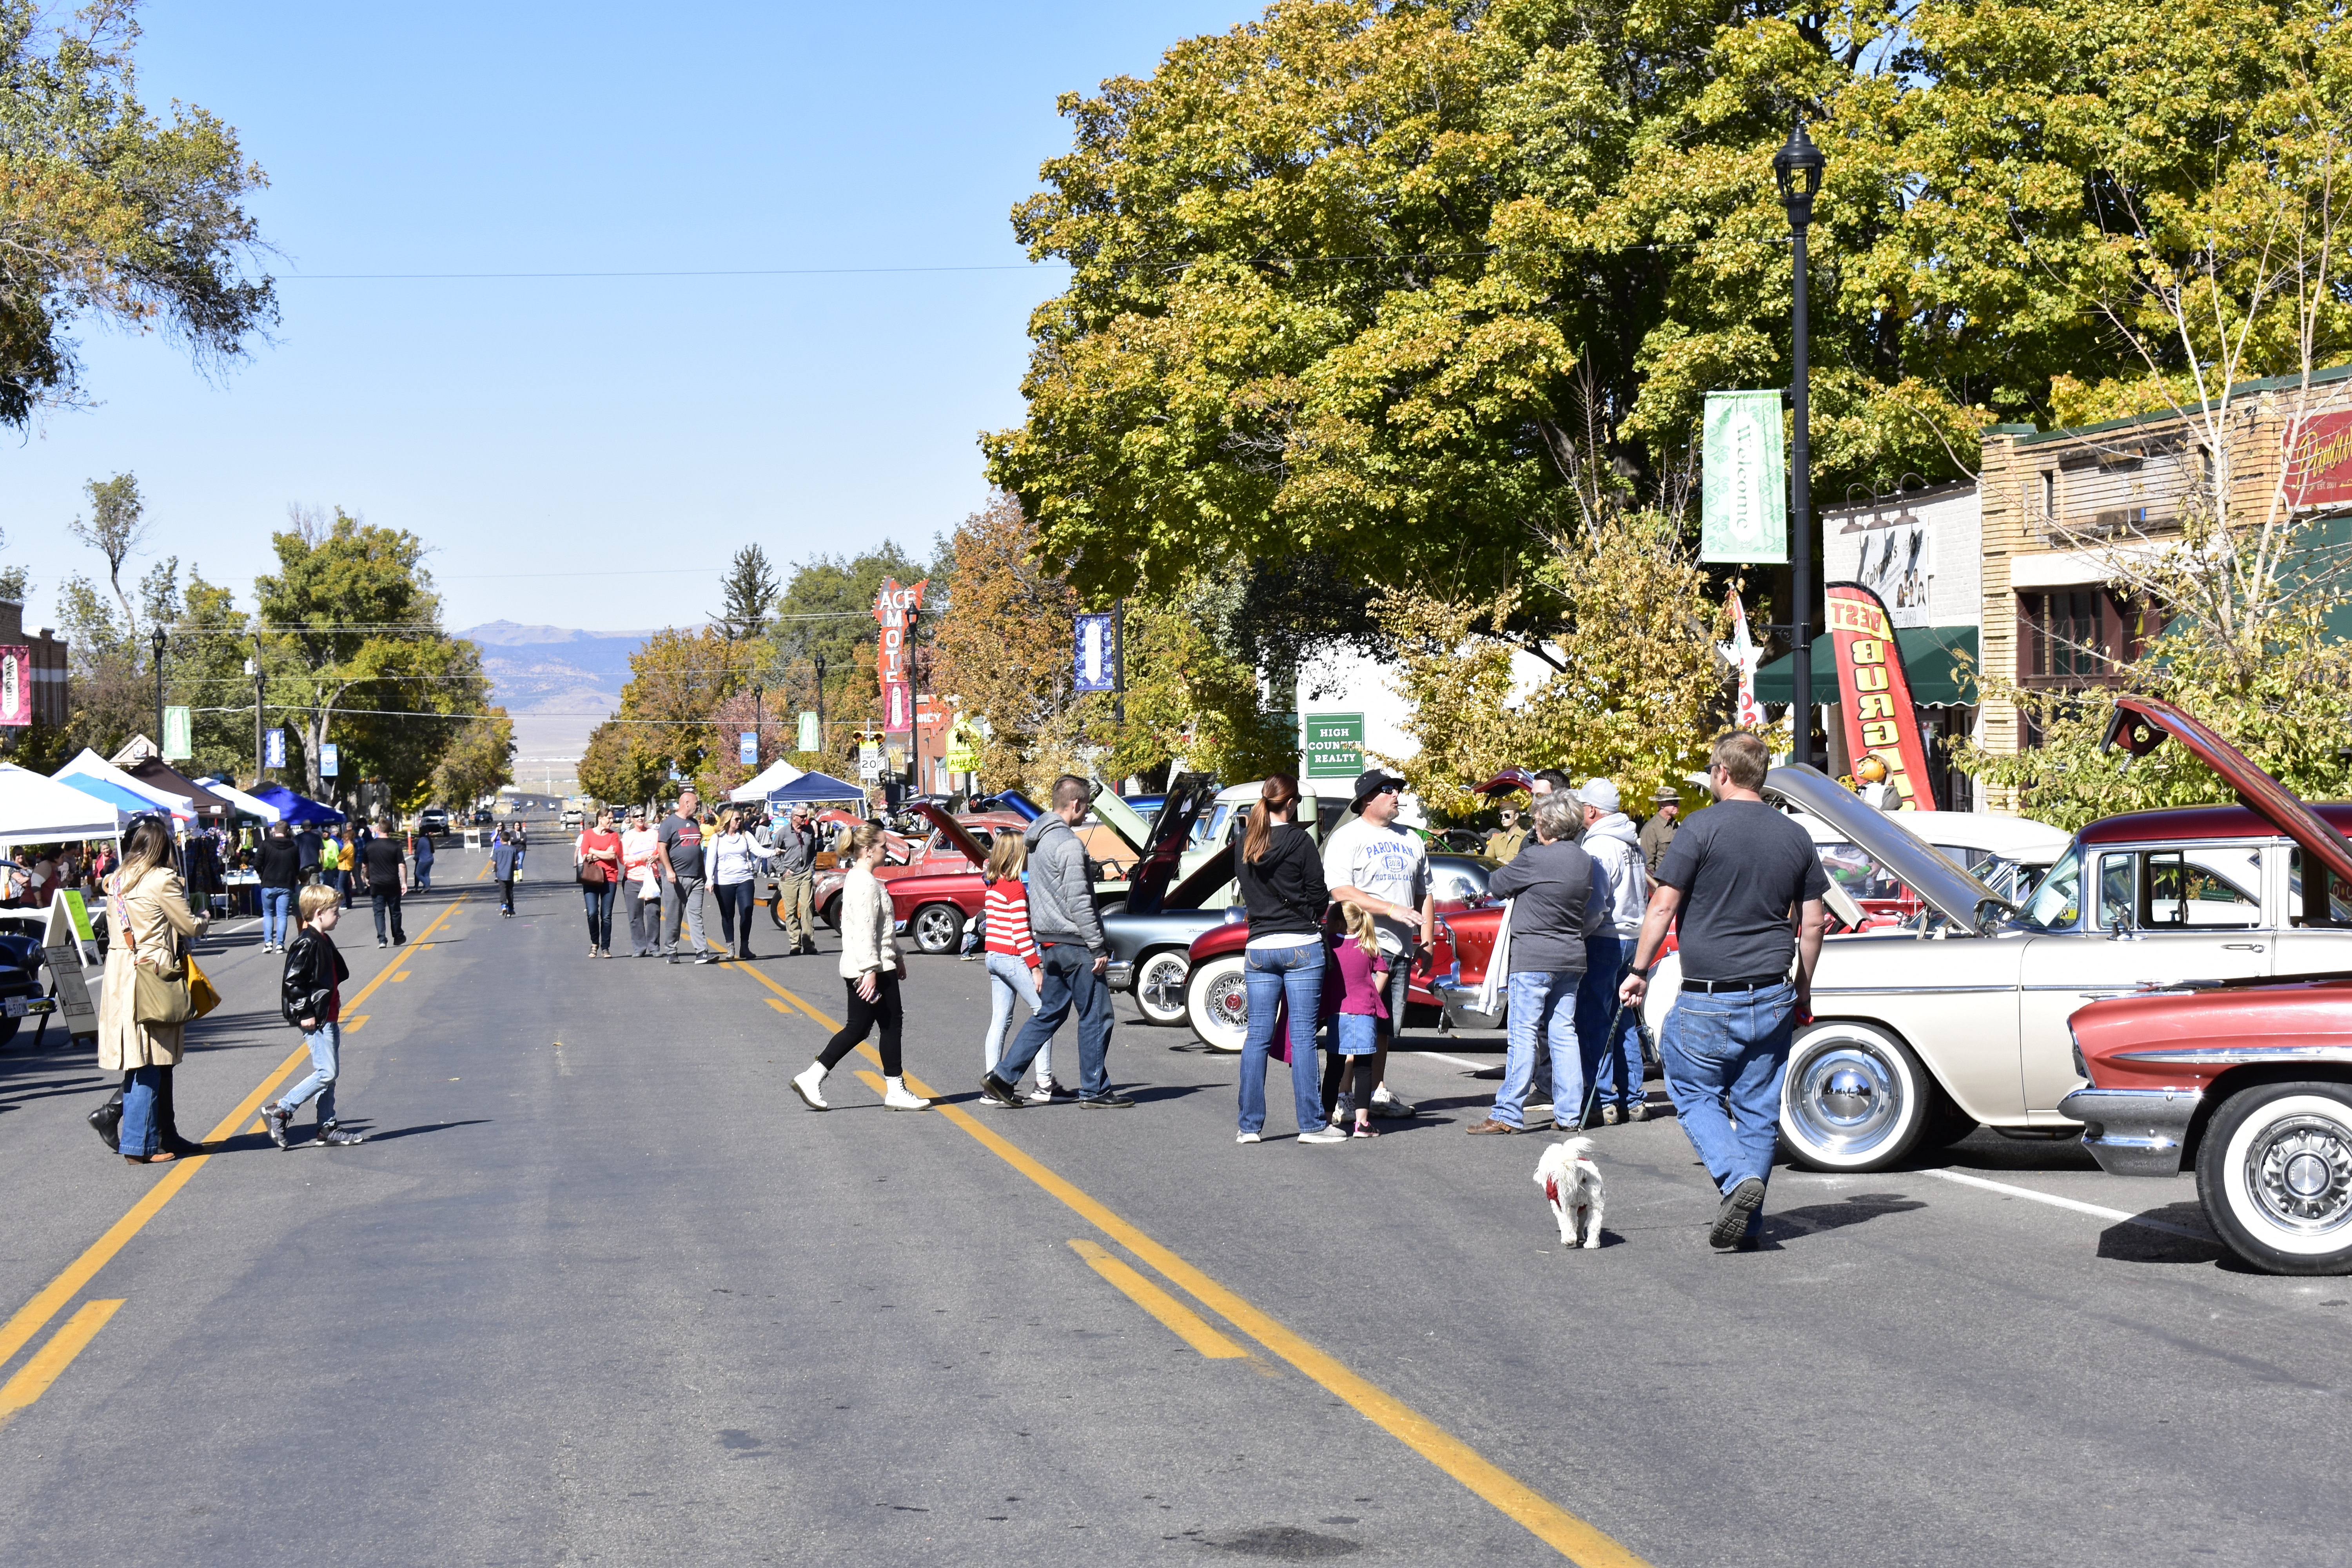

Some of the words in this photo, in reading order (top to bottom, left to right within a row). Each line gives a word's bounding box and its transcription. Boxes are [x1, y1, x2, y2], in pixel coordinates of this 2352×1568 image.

[1736, 425, 1751, 529] Welcome
[886, 610, 902, 682] MOTE
[6, 661, 14, 710] Welcome
[1319, 728, 1349, 737] HIGH
[1314, 753, 1356, 763] REALTY
[970, 799, 977, 808] 40
[1366, 842, 1415, 859] PAROWAN
